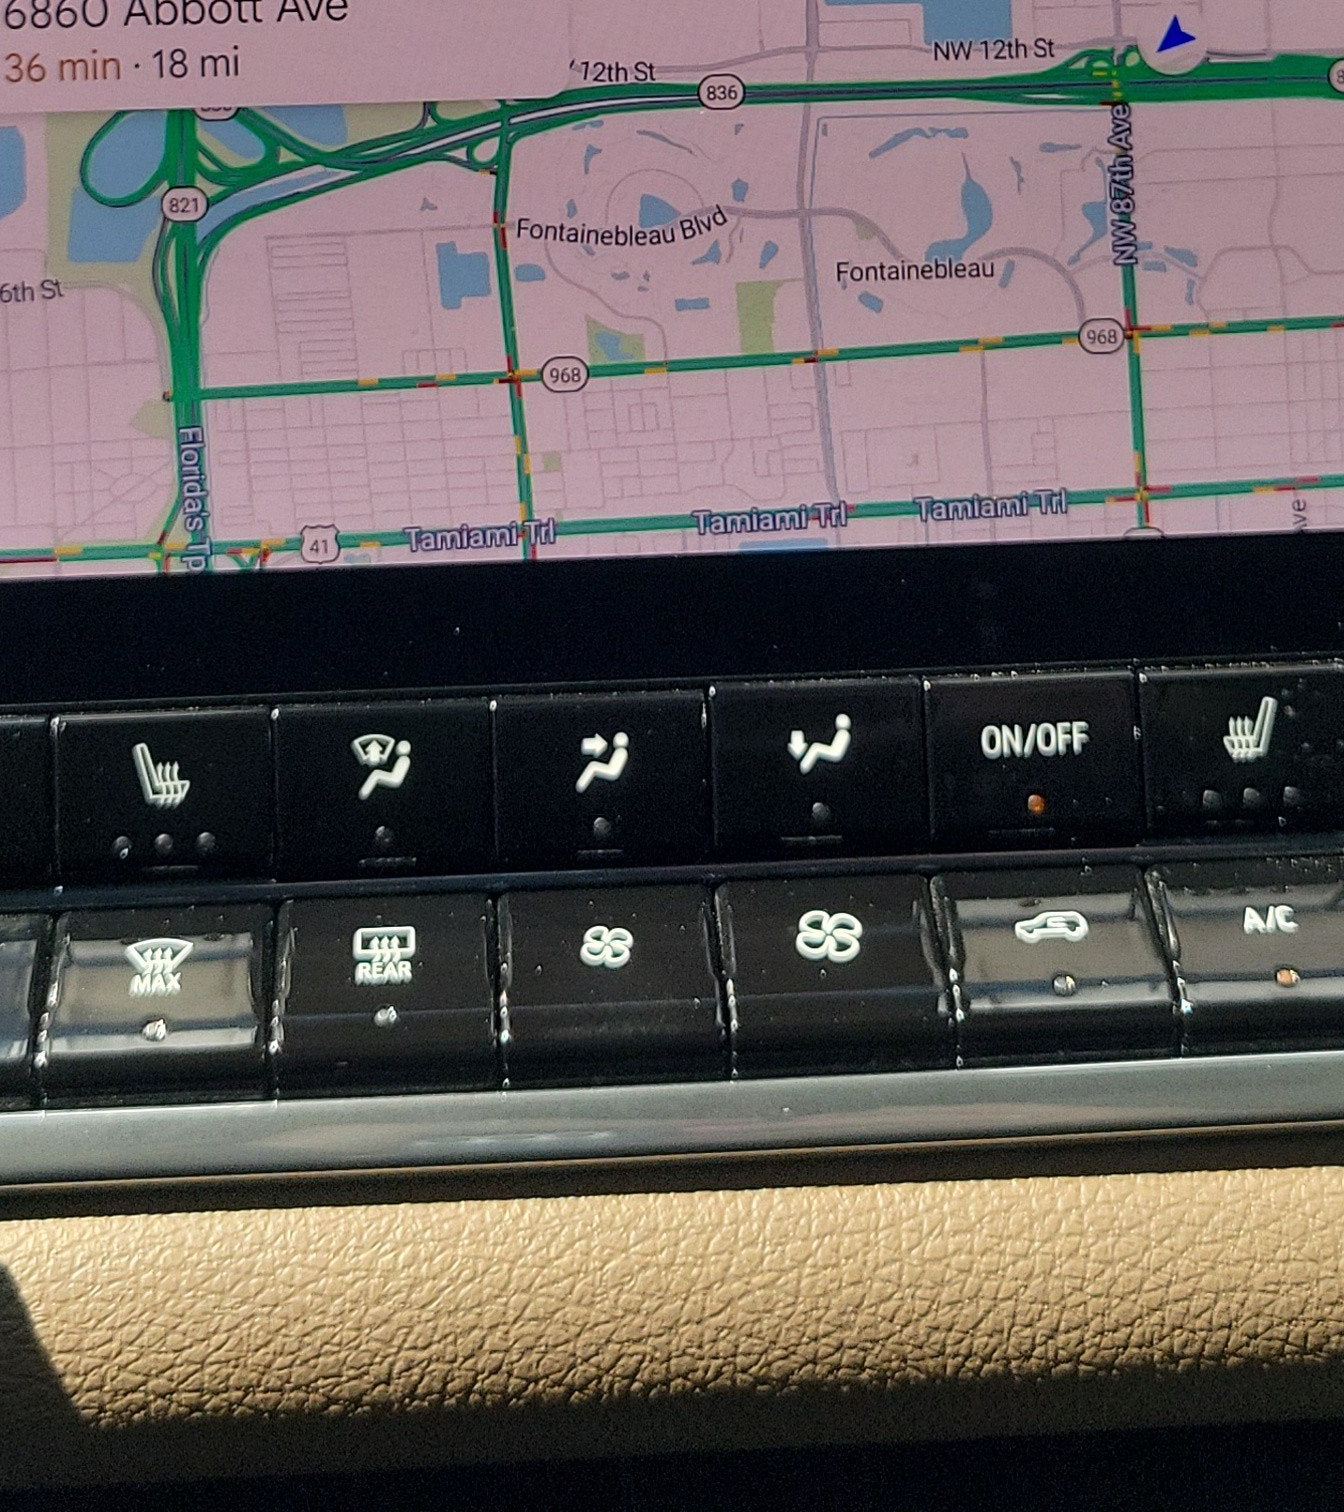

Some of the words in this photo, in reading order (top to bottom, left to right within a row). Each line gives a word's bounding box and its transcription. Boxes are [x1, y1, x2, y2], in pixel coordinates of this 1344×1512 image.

[933, 41, 972, 60] NW
[978, 39, 1024, 59] 12th
[1031, 38, 1054, 58] St
[5, 52, 46, 83] 36
[59, 50, 121, 81] min
[153, 49, 188, 79] 18
[200, 46, 240, 76] mi
[634, 61, 655, 81] St
[705, 84, 738, 100] 836
[1106, 103, 1132, 149] Ave
[1109, 158, 1136, 216] 87th
[168, 197, 197, 213] 821
[516, 217, 675, 247] Fontainebleau
[680, 204, 728, 240] Blvd
[1111, 222, 1139, 266] NW
[836, 259, 995, 284] Fontainebleau
[0, 283, 34, 303] 6th
[40, 280, 63, 299] St
[1087, 328, 1117, 345] 968
[550, 367, 581, 383] 968
[179, 426, 210, 532] Florida's
[692, 508, 806, 536] Tamiami
[811, 502, 848, 529] Trl
[916, 496, 1027, 524] Tamiami
[1033, 490, 1068, 516] Trl
[310, 538, 328, 555] 41
[405, 526, 519, 553] Tamiami
[523, 521, 556, 547] Trl
[981, 722, 1089, 761] ON/OFF
[1242, 903, 1297, 936] A/C
[129, 971, 181, 997] MAX
[357, 959, 412, 984] REAR
